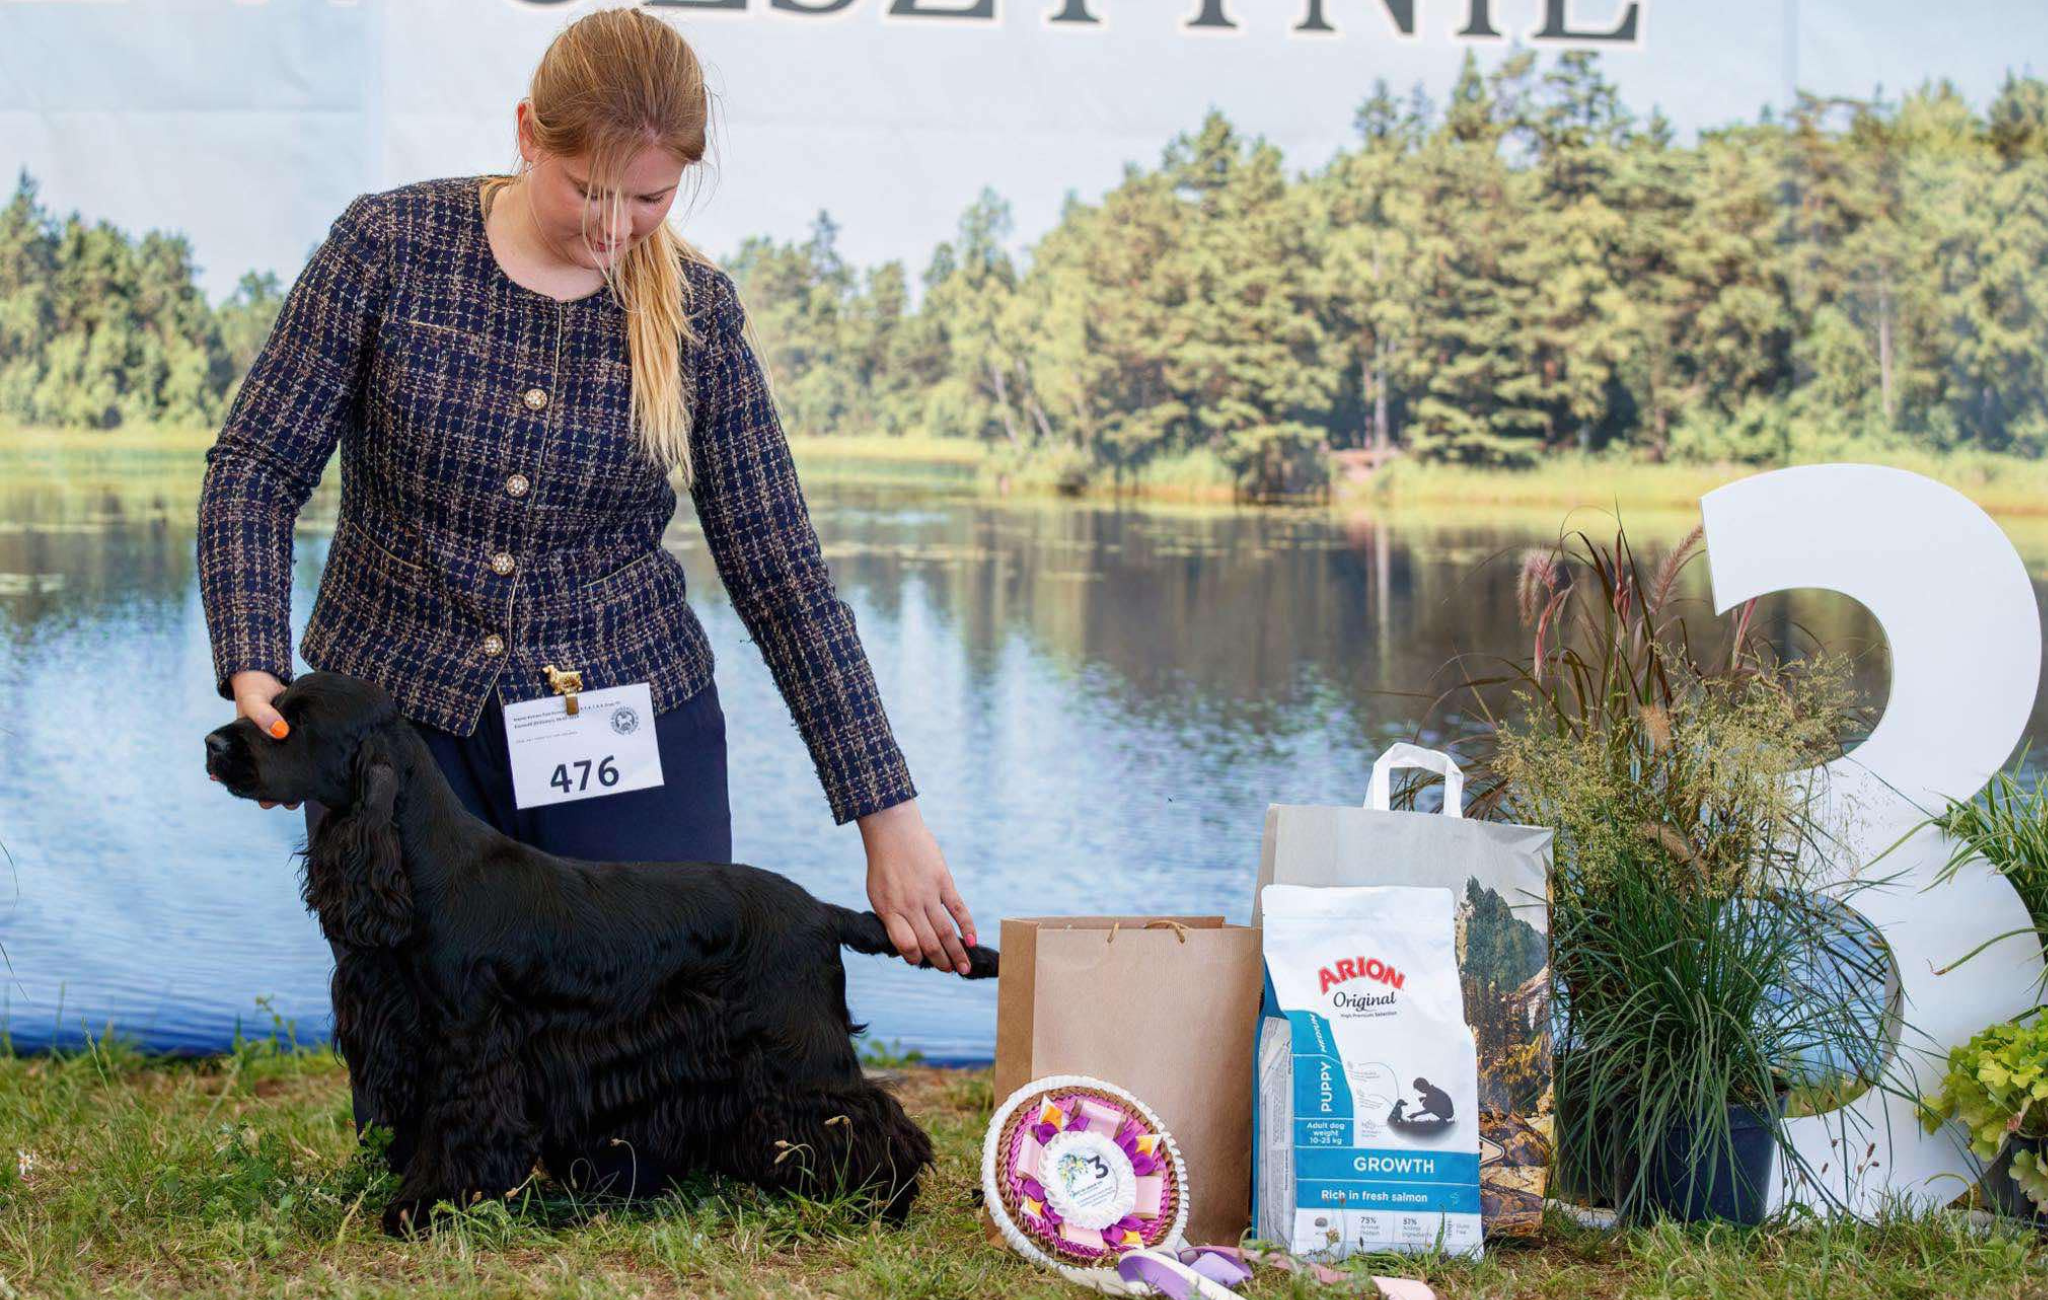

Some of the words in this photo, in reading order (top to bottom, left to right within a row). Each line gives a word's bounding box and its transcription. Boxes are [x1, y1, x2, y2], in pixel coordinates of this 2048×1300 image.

[550, 755, 619, 793] 476
[1700, 463, 2043, 1222] 3
[1318, 955, 1405, 995] ARION
[1333, 991, 1397, 1012] Original
[1310, 1013, 1327, 1053] MEDIUM
[1320, 1061, 1332, 1112] PUPPY
[1306, 1121, 1328, 1129] Adult
[1329, 1121, 1346, 1130] dog
[1313, 1129, 1339, 1137] weight
[1332, 1136, 1343, 1145] kg
[1087, 1155, 1109, 1179] 3
[1353, 1156, 1435, 1174] GROWTH
[1321, 1189, 1346, 1200] Rich
[1349, 1189, 1359, 1200] in
[1362, 1190, 1389, 1201] fresh
[1392, 1192, 1428, 1203] salmon
